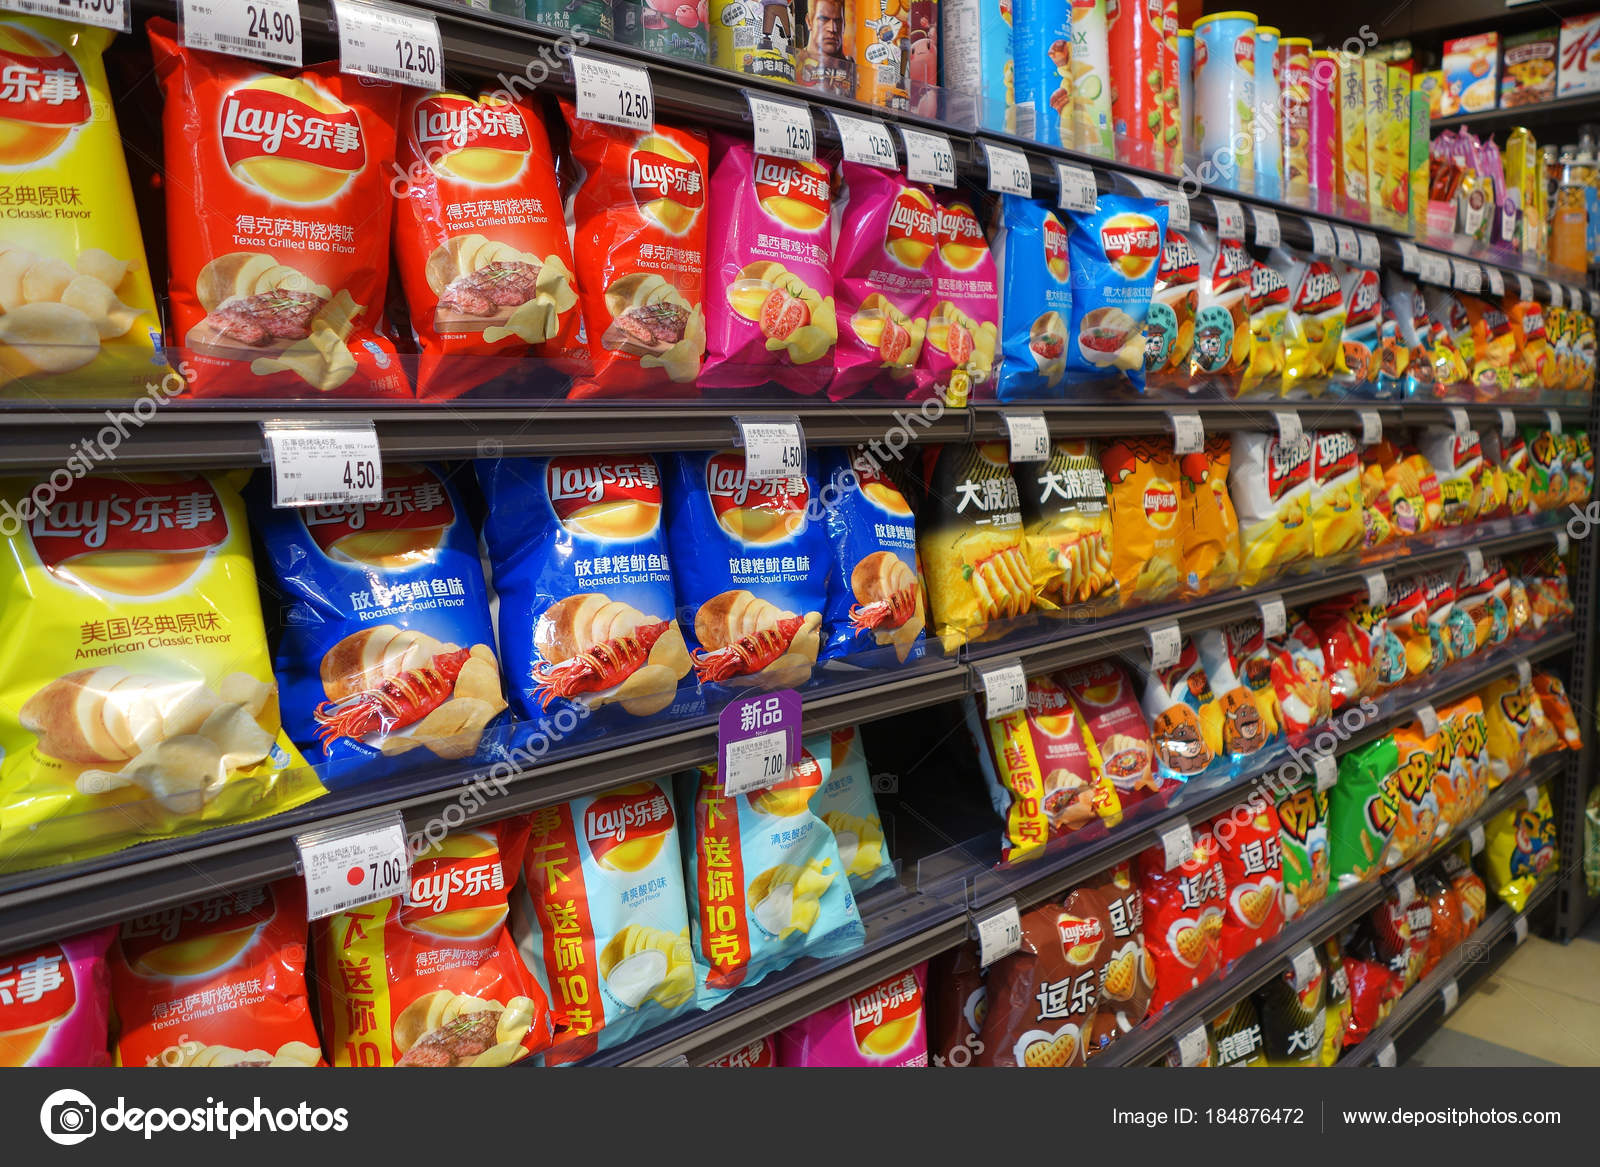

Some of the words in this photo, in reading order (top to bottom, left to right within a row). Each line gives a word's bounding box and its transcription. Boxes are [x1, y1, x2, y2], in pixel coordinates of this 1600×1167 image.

[247, 5, 294, 45] 24.90
[396, 39, 436, 75] 12.50
[619, 90, 648, 120] 12.50
[786, 125, 811, 151] 12.50
[869, 135, 892, 158] 12.50
[933, 152, 953, 173] 12.50
[7, 207, 53, 219] Classic
[55, 208, 91, 220] Flavor
[445, 199, 544, 219] 得克萨斯烧烤味
[235, 215, 355, 244] 得克萨斯烧烤味
[446, 220, 475, 231] Texas
[476, 217, 507, 229] Grilled
[508, 215, 526, 225] BBQ
[527, 213, 549, 223] Flavor
[232, 234, 266, 246] Texas
[268, 236, 305, 251] Grilled
[307, 241, 330, 253] BBQ
[332, 243, 356, 255] Flavor
[750, 247, 778, 258] Mexican
[779, 252, 803, 262] Tomato
[636, 259, 660, 269] Texas
[782, 446, 801, 467] 4.50
[1035, 437, 1048, 454] 4.50
[343, 461, 375, 489] 4.50
[574, 552, 670, 577] 放肆烤鱿鱼味
[728, 555, 811, 574] 放肆烤鱿鱼味
[578, 575, 621, 588] Roasted
[622, 572, 649, 585] Squid
[732, 575, 759, 584] Roasted
[760, 574, 782, 584] Squid
[783, 572, 808, 583] Flavor
[359, 604, 407, 621] Roasted
[407, 598, 437, 613] Squid
[437, 597, 465, 610] Flavor
[80, 610, 223, 645] 美国经典原味
[75, 638, 146, 660] American
[147, 635, 193, 650] Classic
[195, 632, 232, 645] Flavor
[1010, 684, 1025, 703] 7.00
[741, 697, 783, 732] 新品
[763, 753, 782, 778] 7.00
[369, 858, 400, 891] 7.00
[620, 876, 667, 905] 清爽酸奶味
[416, 968, 436, 977] Texas
[151, 978, 263, 1020] 得克萨斯烧烤味
[152, 1017, 181, 1032] Texas
[182, 1008, 216, 1026] Grilled
[216, 1002, 238, 1015] BBQ
[238, 994, 266, 1009] Flavor
